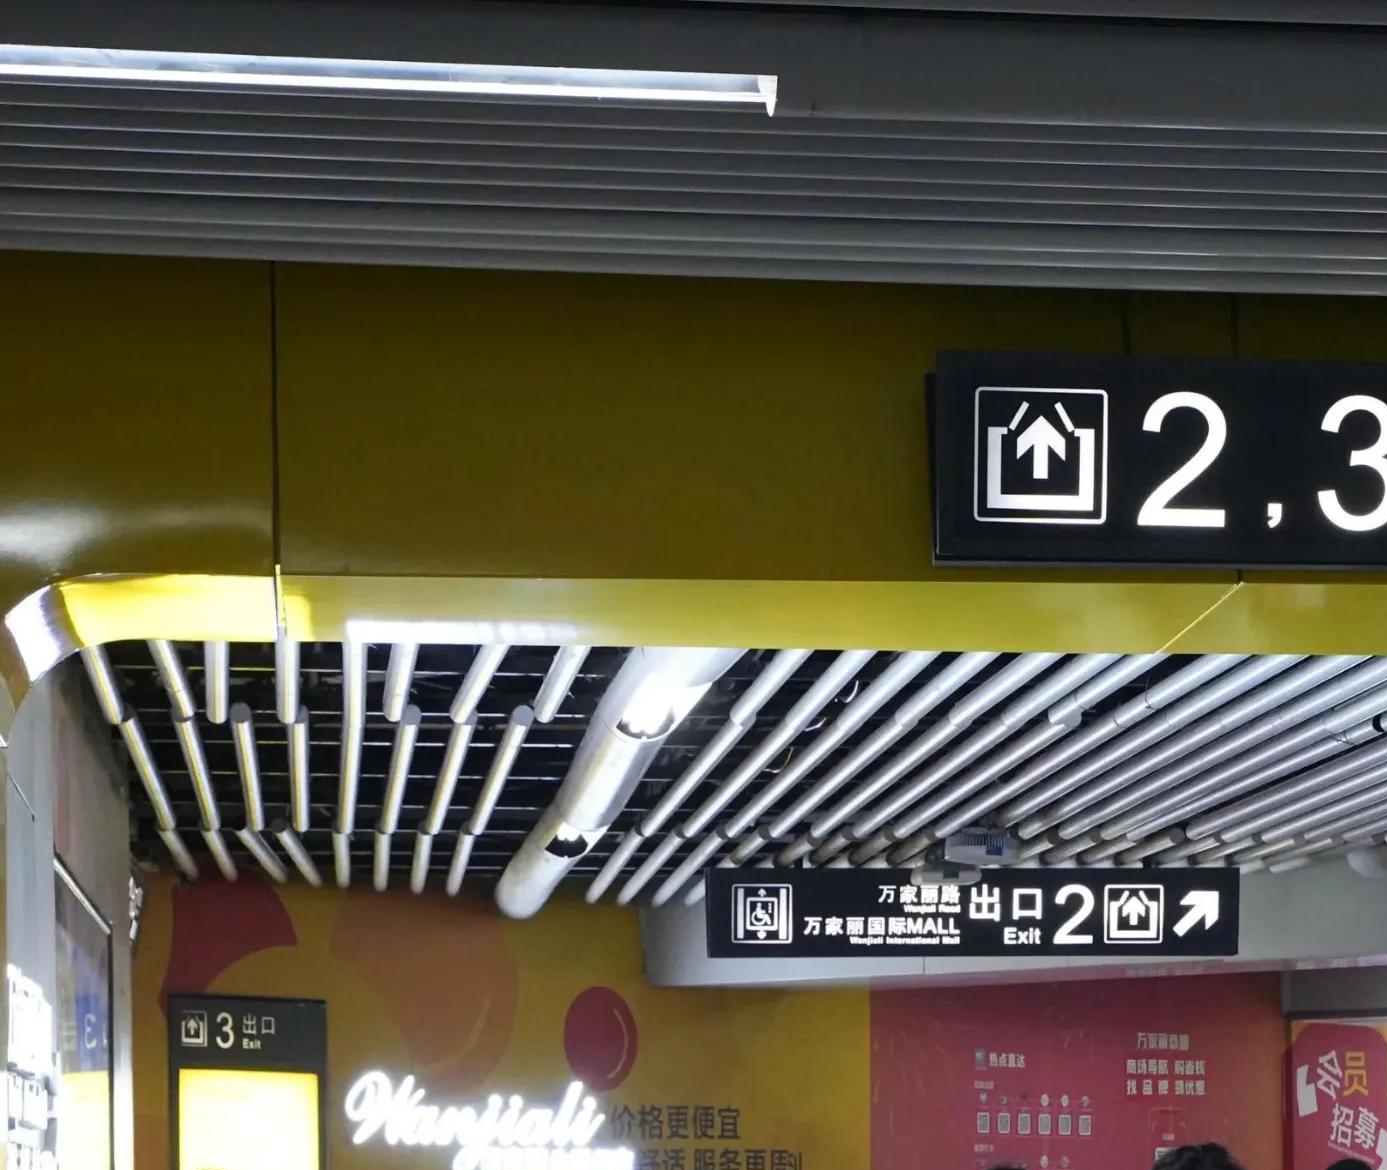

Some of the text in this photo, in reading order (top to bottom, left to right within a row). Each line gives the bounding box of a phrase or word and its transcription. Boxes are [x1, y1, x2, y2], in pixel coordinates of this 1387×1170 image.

[878, 884, 961, 904] 万家丽路
[803, 916, 961, 936] 万家丽国际MALL
[969, 884, 1095, 945] 出口 2
[1003, 927, 1042, 945] Exit
[215, 1011, 276, 1049] 3 出口
[242, 1037, 262, 1050] Exit
[1316, 1050, 1369, 1101] 会员
[611, 1104, 742, 1141] 价格更便宜
[1329, 1102, 1379, 1150] 招募
